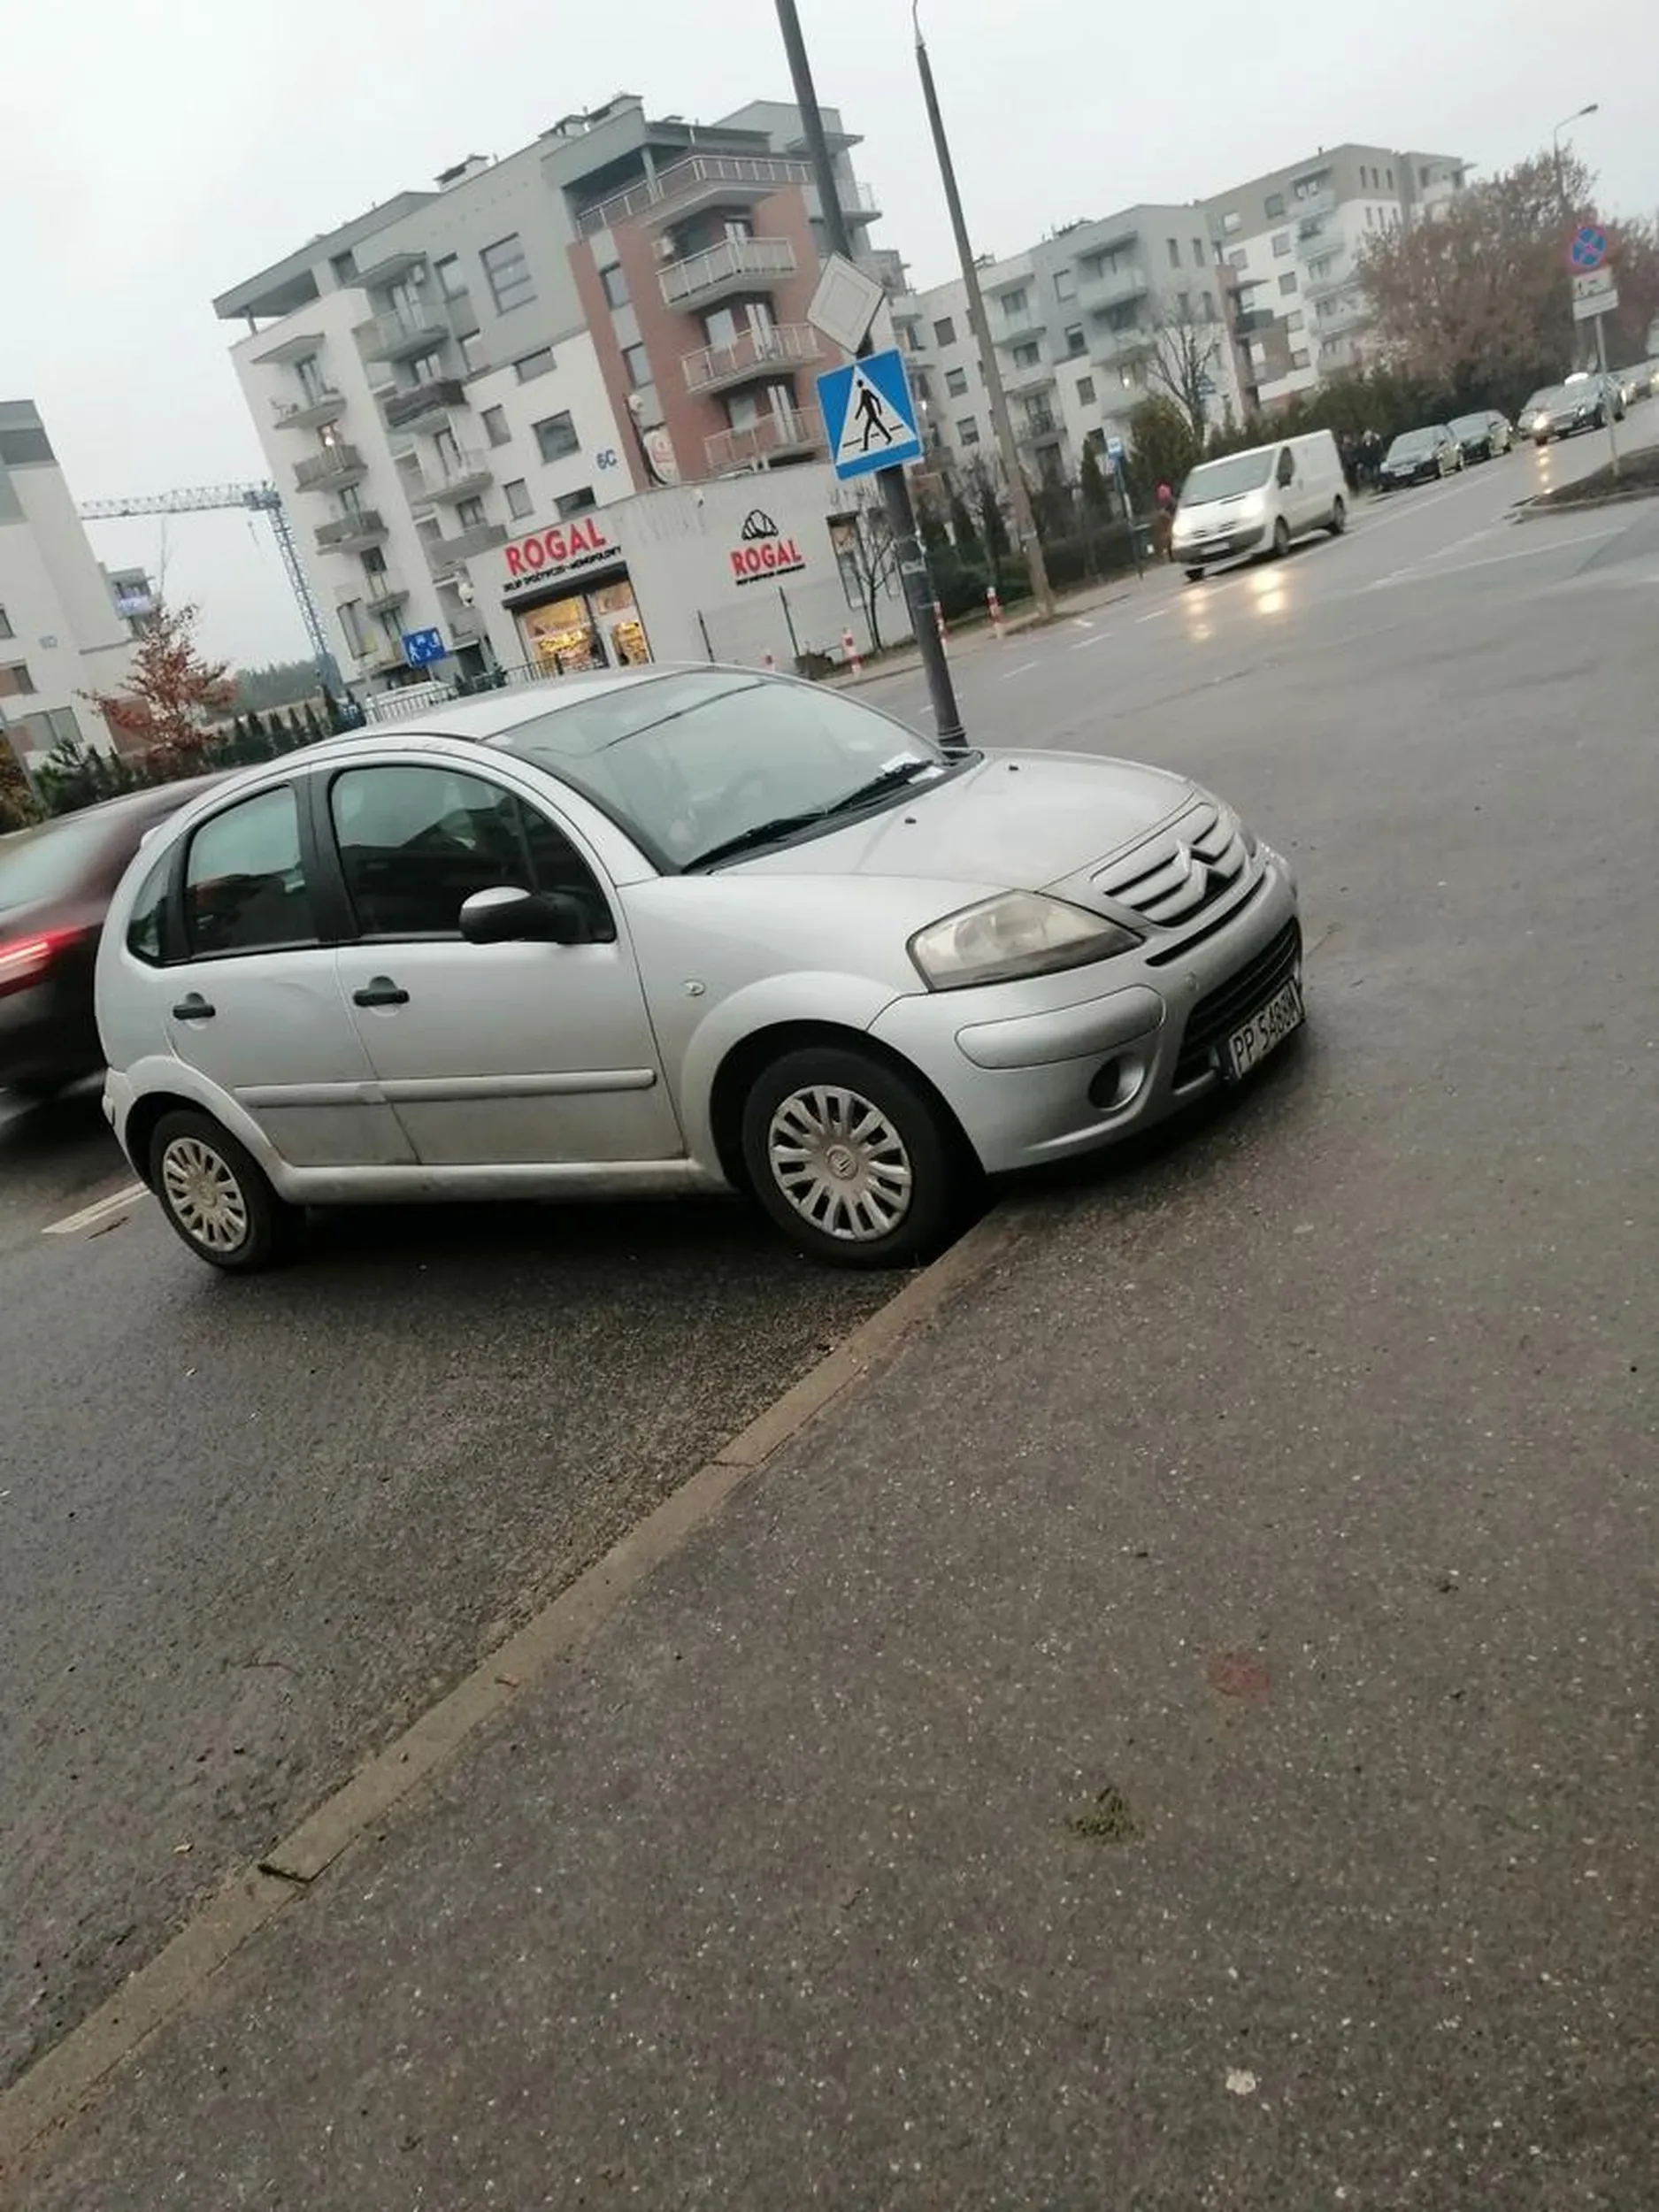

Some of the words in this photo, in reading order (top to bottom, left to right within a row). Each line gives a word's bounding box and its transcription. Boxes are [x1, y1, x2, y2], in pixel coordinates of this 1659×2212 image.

[505, 518, 606, 576] ROGAL
[731, 539, 802, 575] ROGAL
[1233, 1028, 1255, 1071] PP
